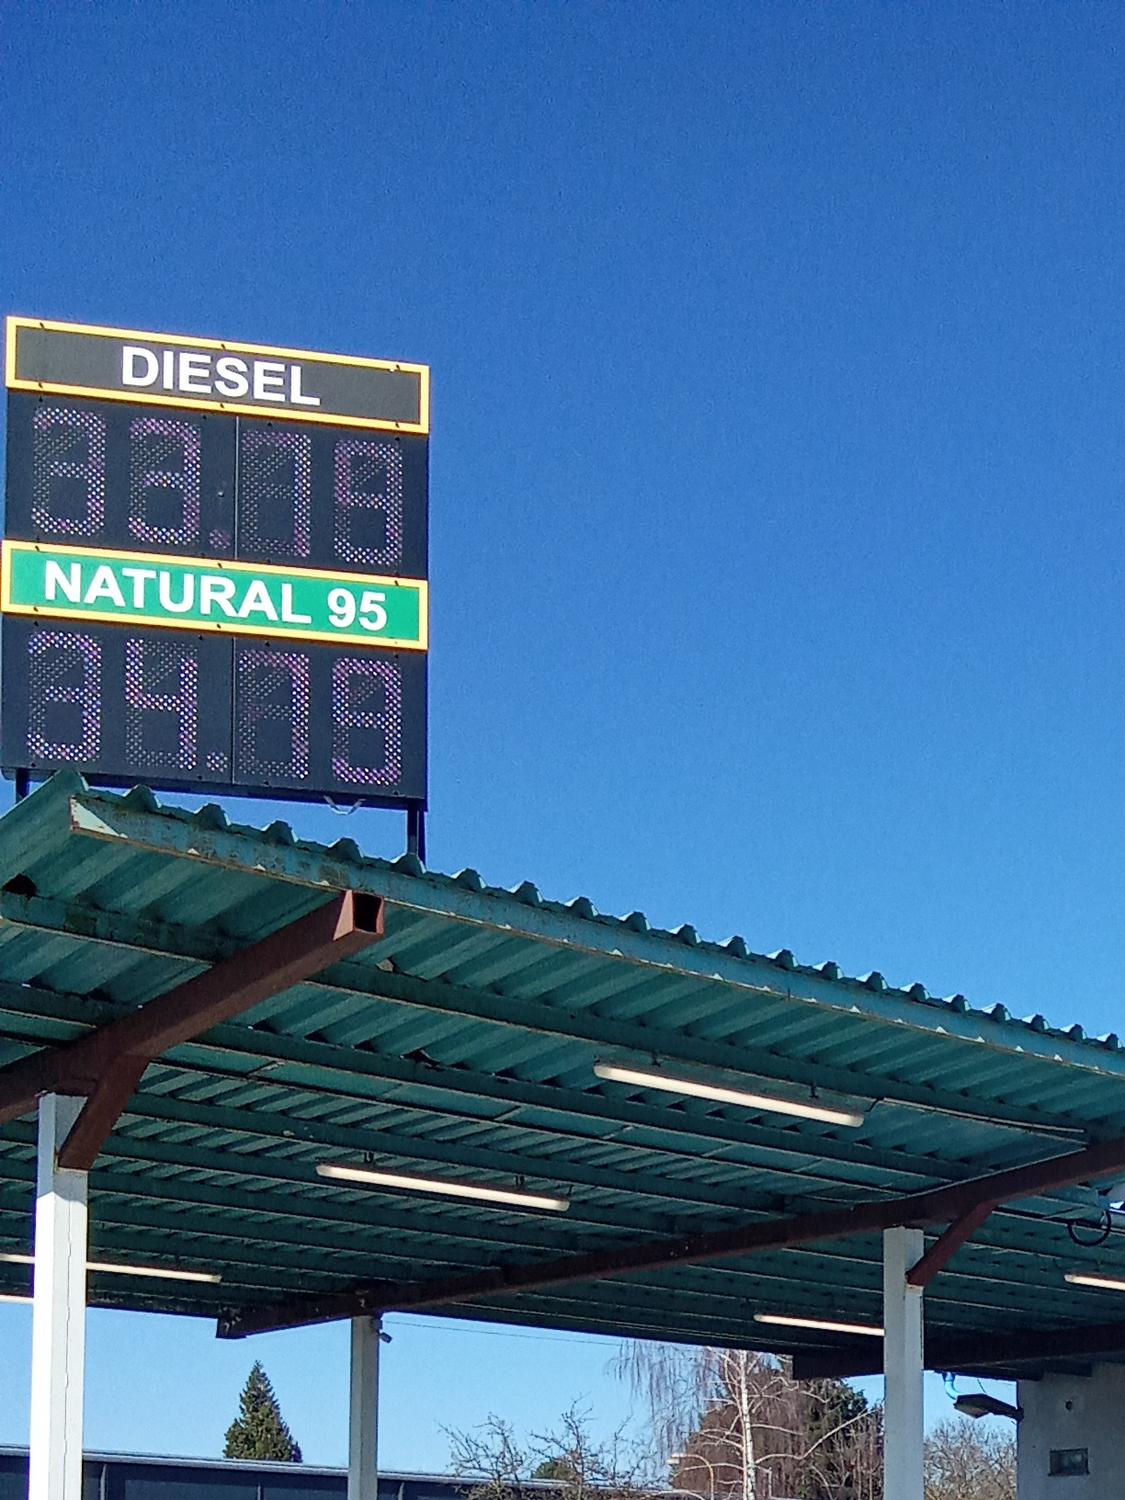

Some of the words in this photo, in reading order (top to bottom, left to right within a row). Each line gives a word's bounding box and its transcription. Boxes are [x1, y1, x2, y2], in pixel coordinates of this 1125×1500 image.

[121, 345, 321, 407] DIESEL
[43, 559, 313, 625] NATURAL
[327, 587, 388, 632] 95
